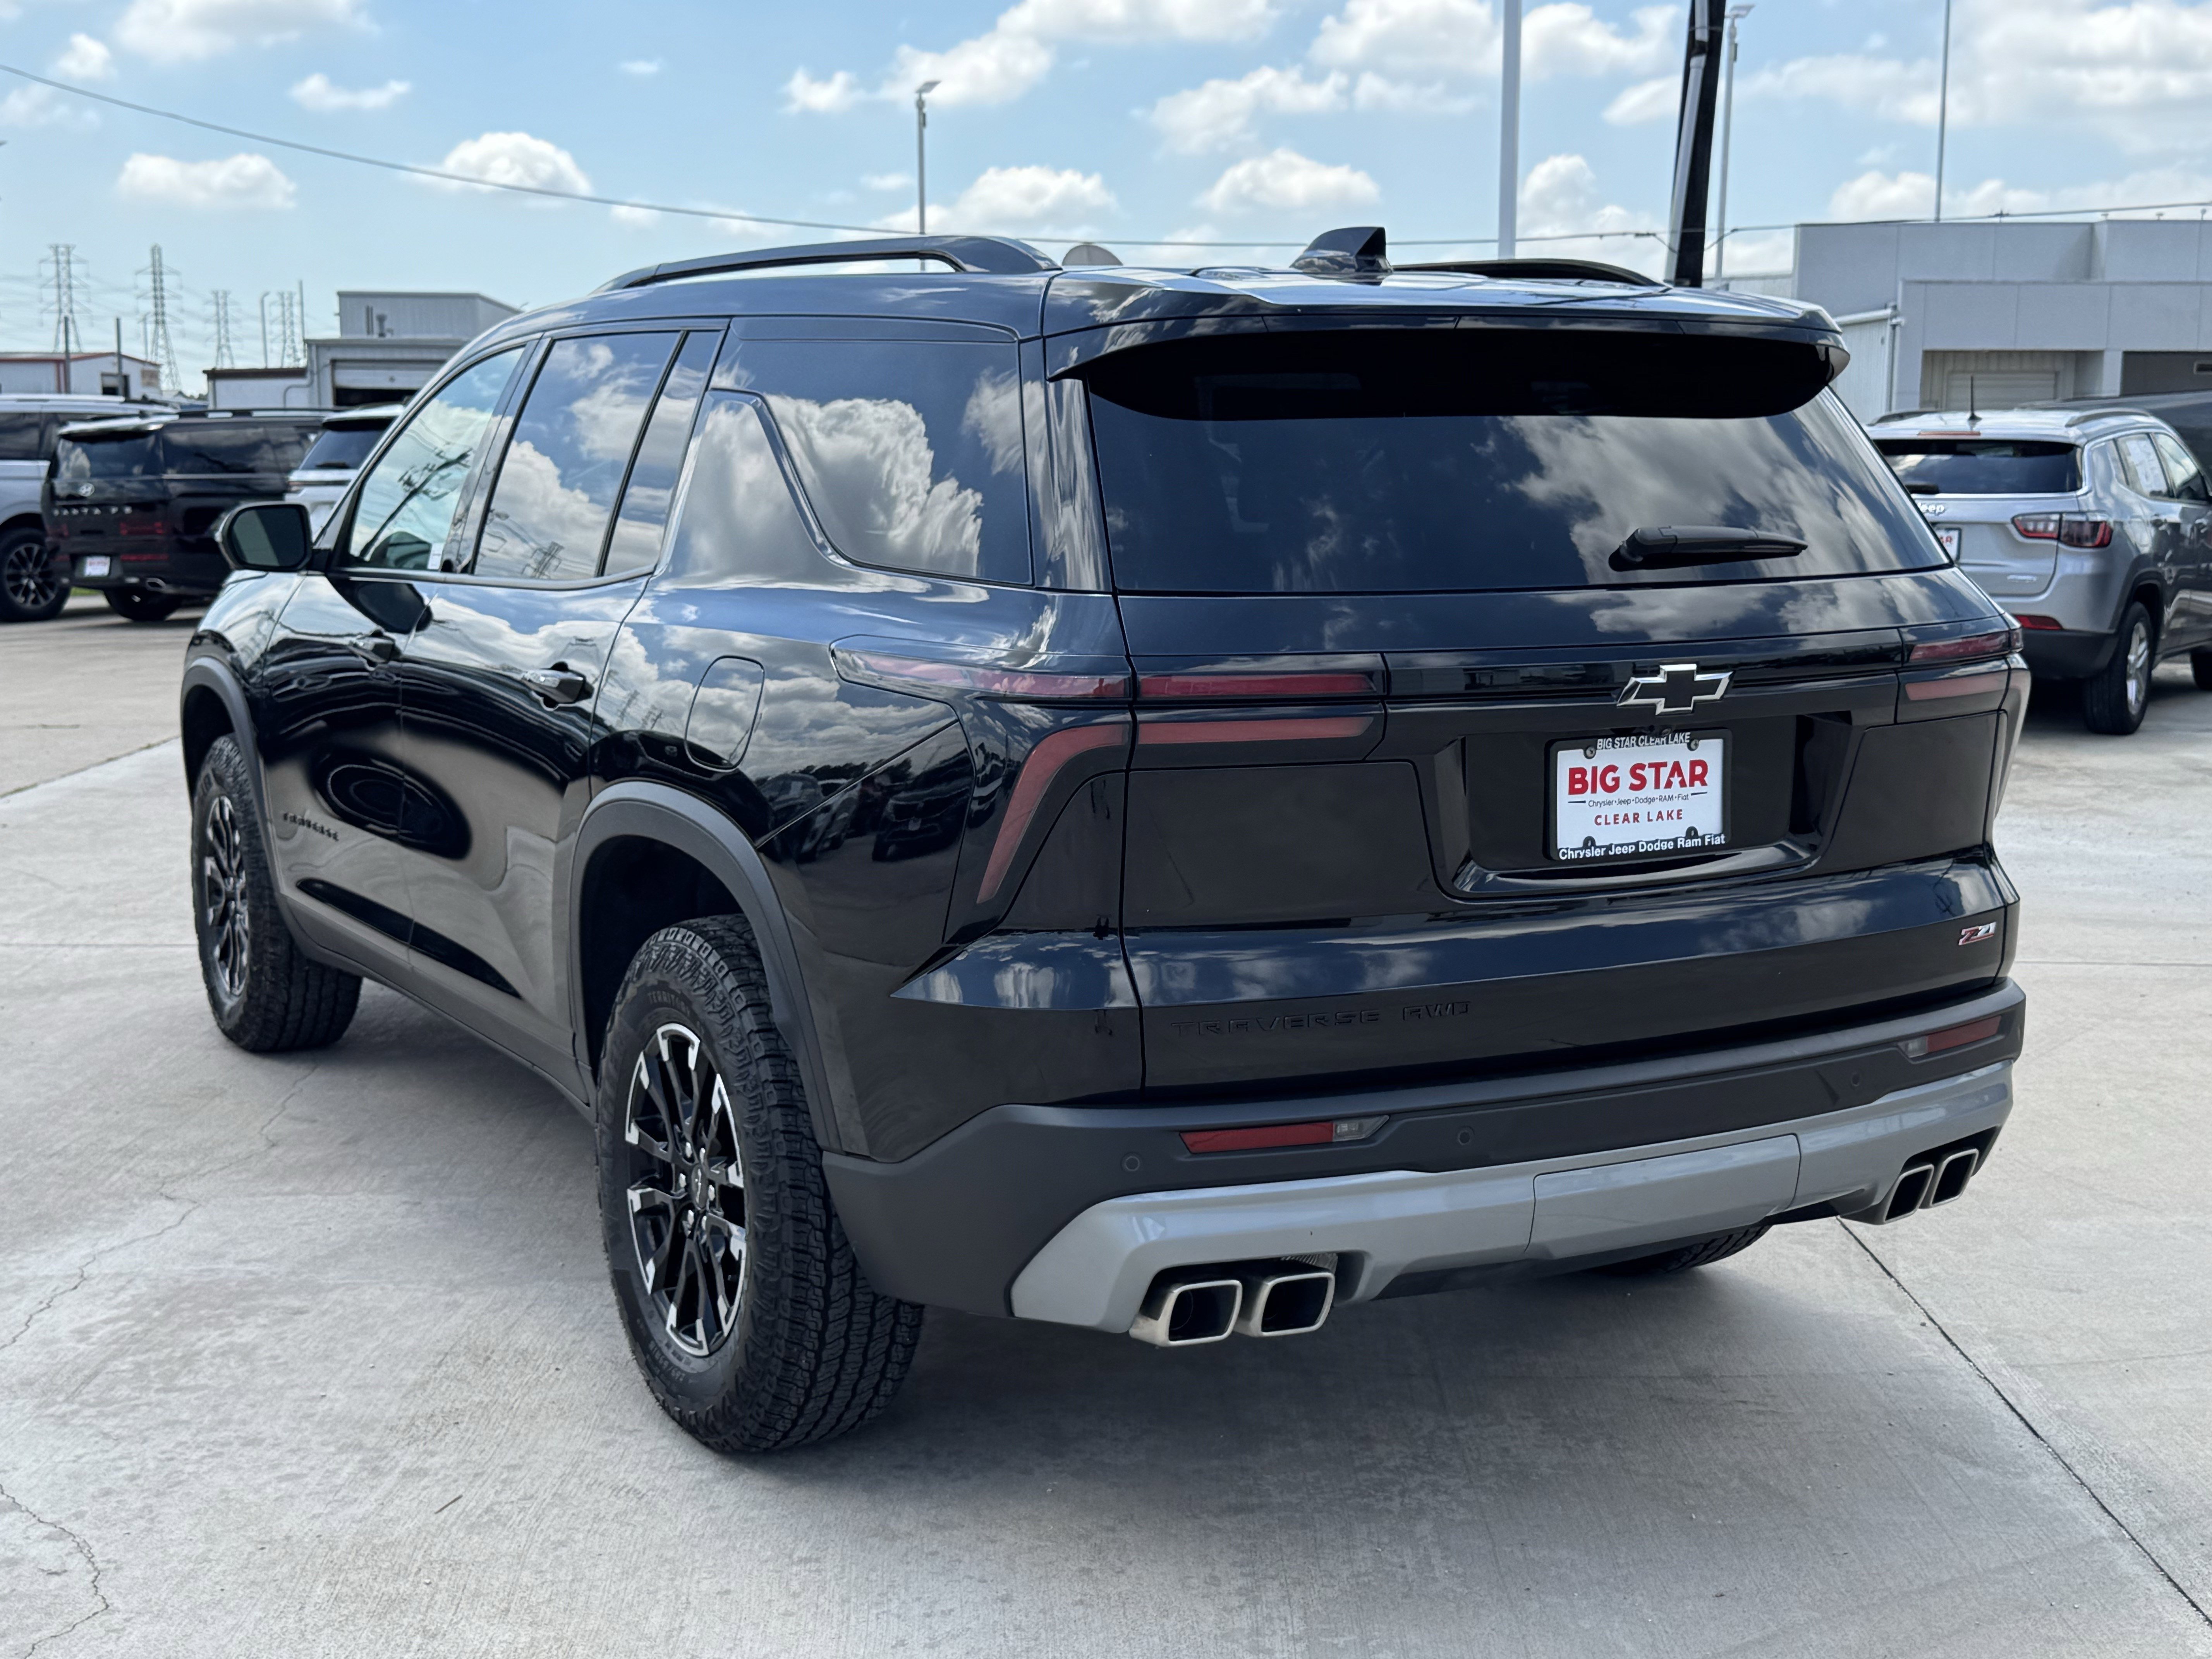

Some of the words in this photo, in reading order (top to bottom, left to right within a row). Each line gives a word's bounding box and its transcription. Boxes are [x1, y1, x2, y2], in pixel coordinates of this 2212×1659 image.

[1597, 738, 1612, 750] BIG
[1614, 736, 1637, 749] STAR
[1638, 735, 1667, 747] CLEAR
[1668, 732, 1691, 744] LAKE
[1568, 764, 1620, 795] BIG
[1628, 759, 1708, 792] STAR
[1594, 812, 1640, 826] CLEAR
[1647, 809, 1683, 822] LAKE
[1559, 846, 1606, 860] Chrysler
[1609, 844, 1635, 855] Jeep
[1638, 840, 1674, 852] Dodge
[1677, 837, 1702, 848] Ram
[1705, 833, 1726, 845] Fiat
[1958, 922, 1997, 946] Z71
[1171, 1010, 1381, 1036] TRAVERSE
[1403, 1001, 1472, 1021] AWD
